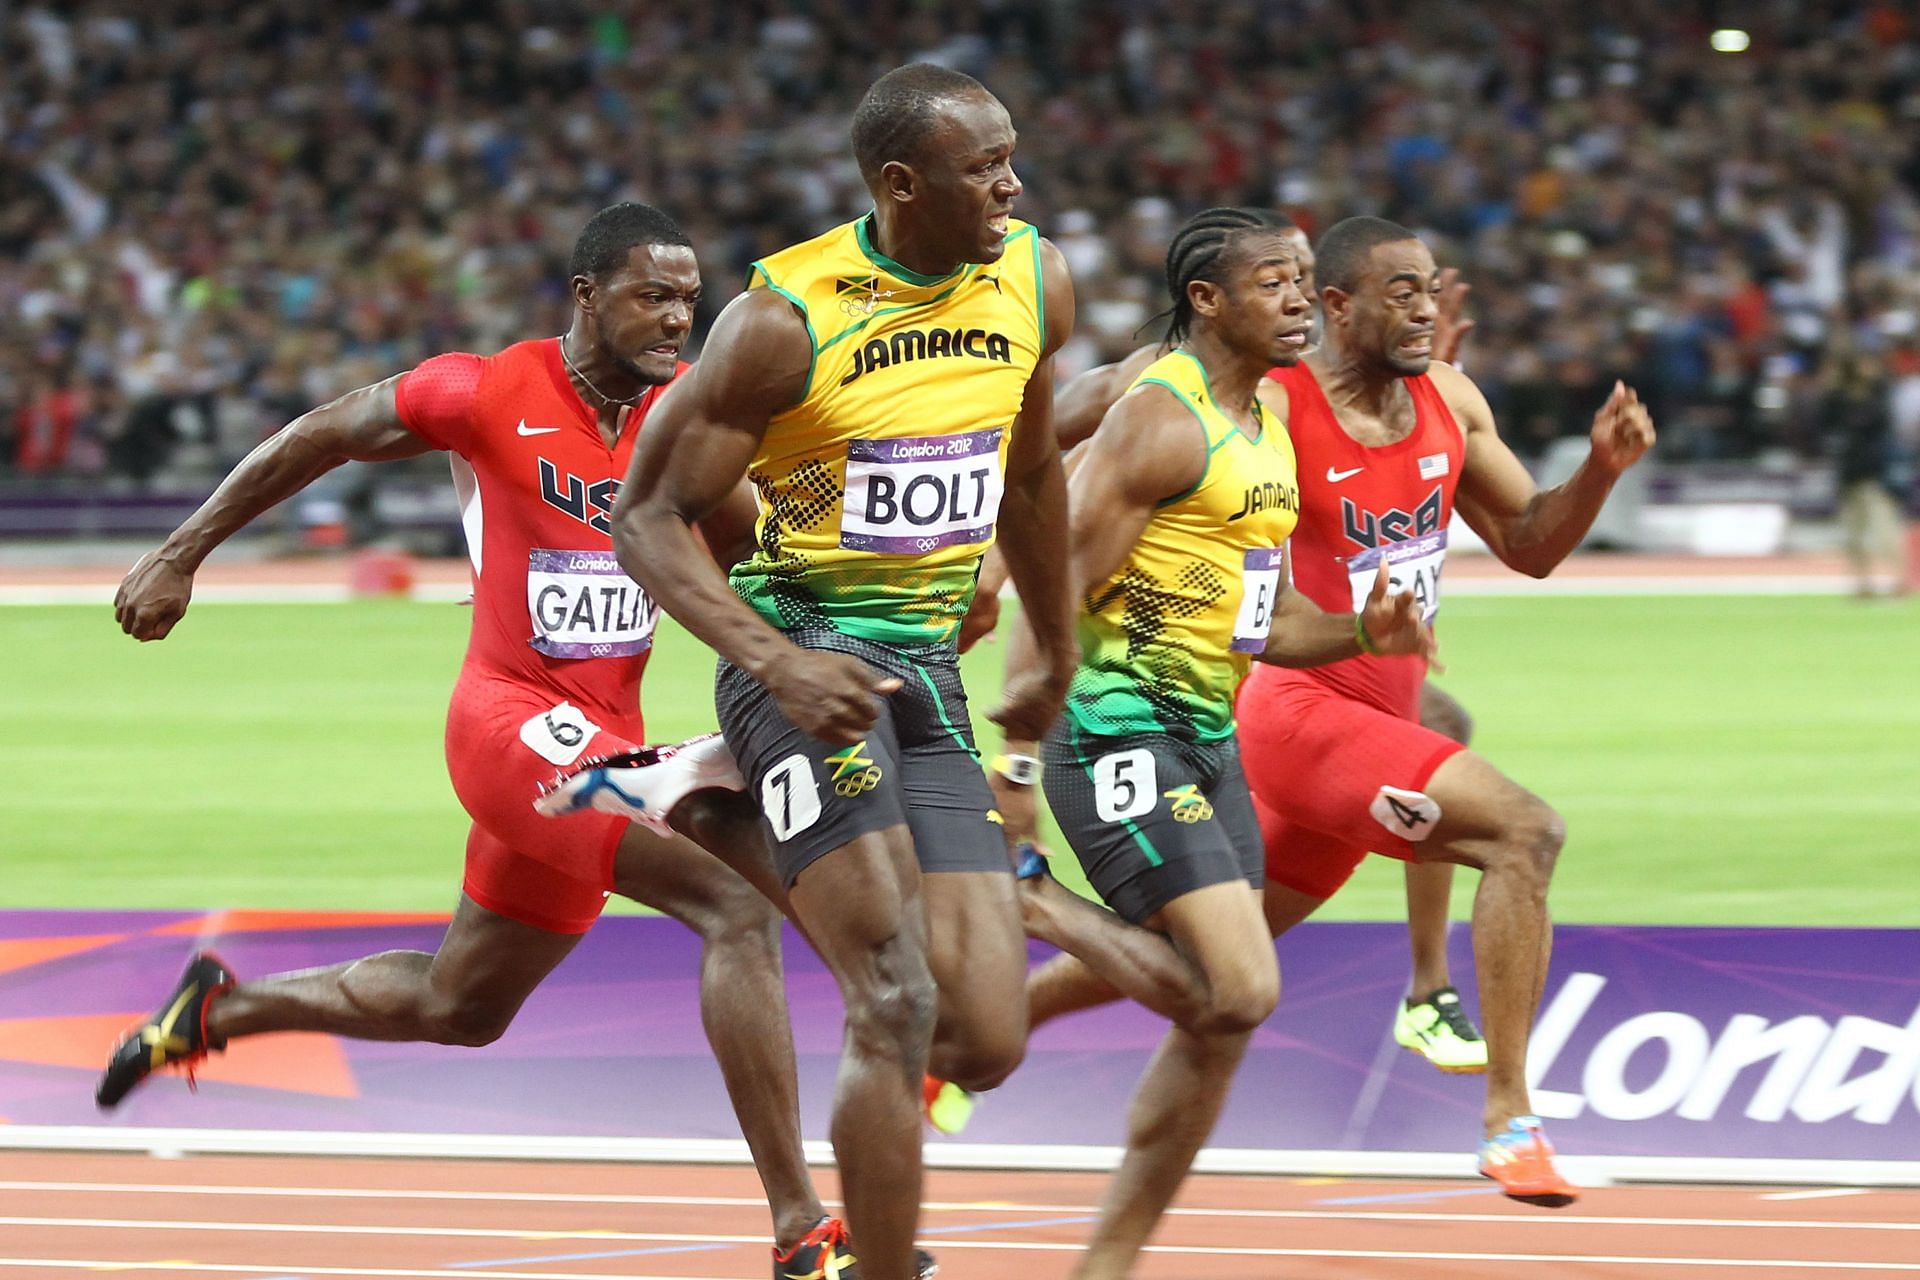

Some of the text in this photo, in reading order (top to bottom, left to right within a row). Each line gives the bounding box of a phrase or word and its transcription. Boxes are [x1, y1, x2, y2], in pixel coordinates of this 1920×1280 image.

[839, 328, 1012, 388] JAMAICA
[892, 438, 973, 459] London 2012
[864, 467, 990, 526] BOLT
[1340, 483, 1443, 550] USA
[569, 556, 619, 572] London
[1389, 564, 1443, 607] AY
[536, 583, 657, 634] GATLIN
[544, 713, 583, 747] 6
[771, 767, 792, 832] 7
[1112, 759, 1136, 813] 5
[1383, 795, 1428, 830] 4
[1525, 972, 1920, 1125] Lond
